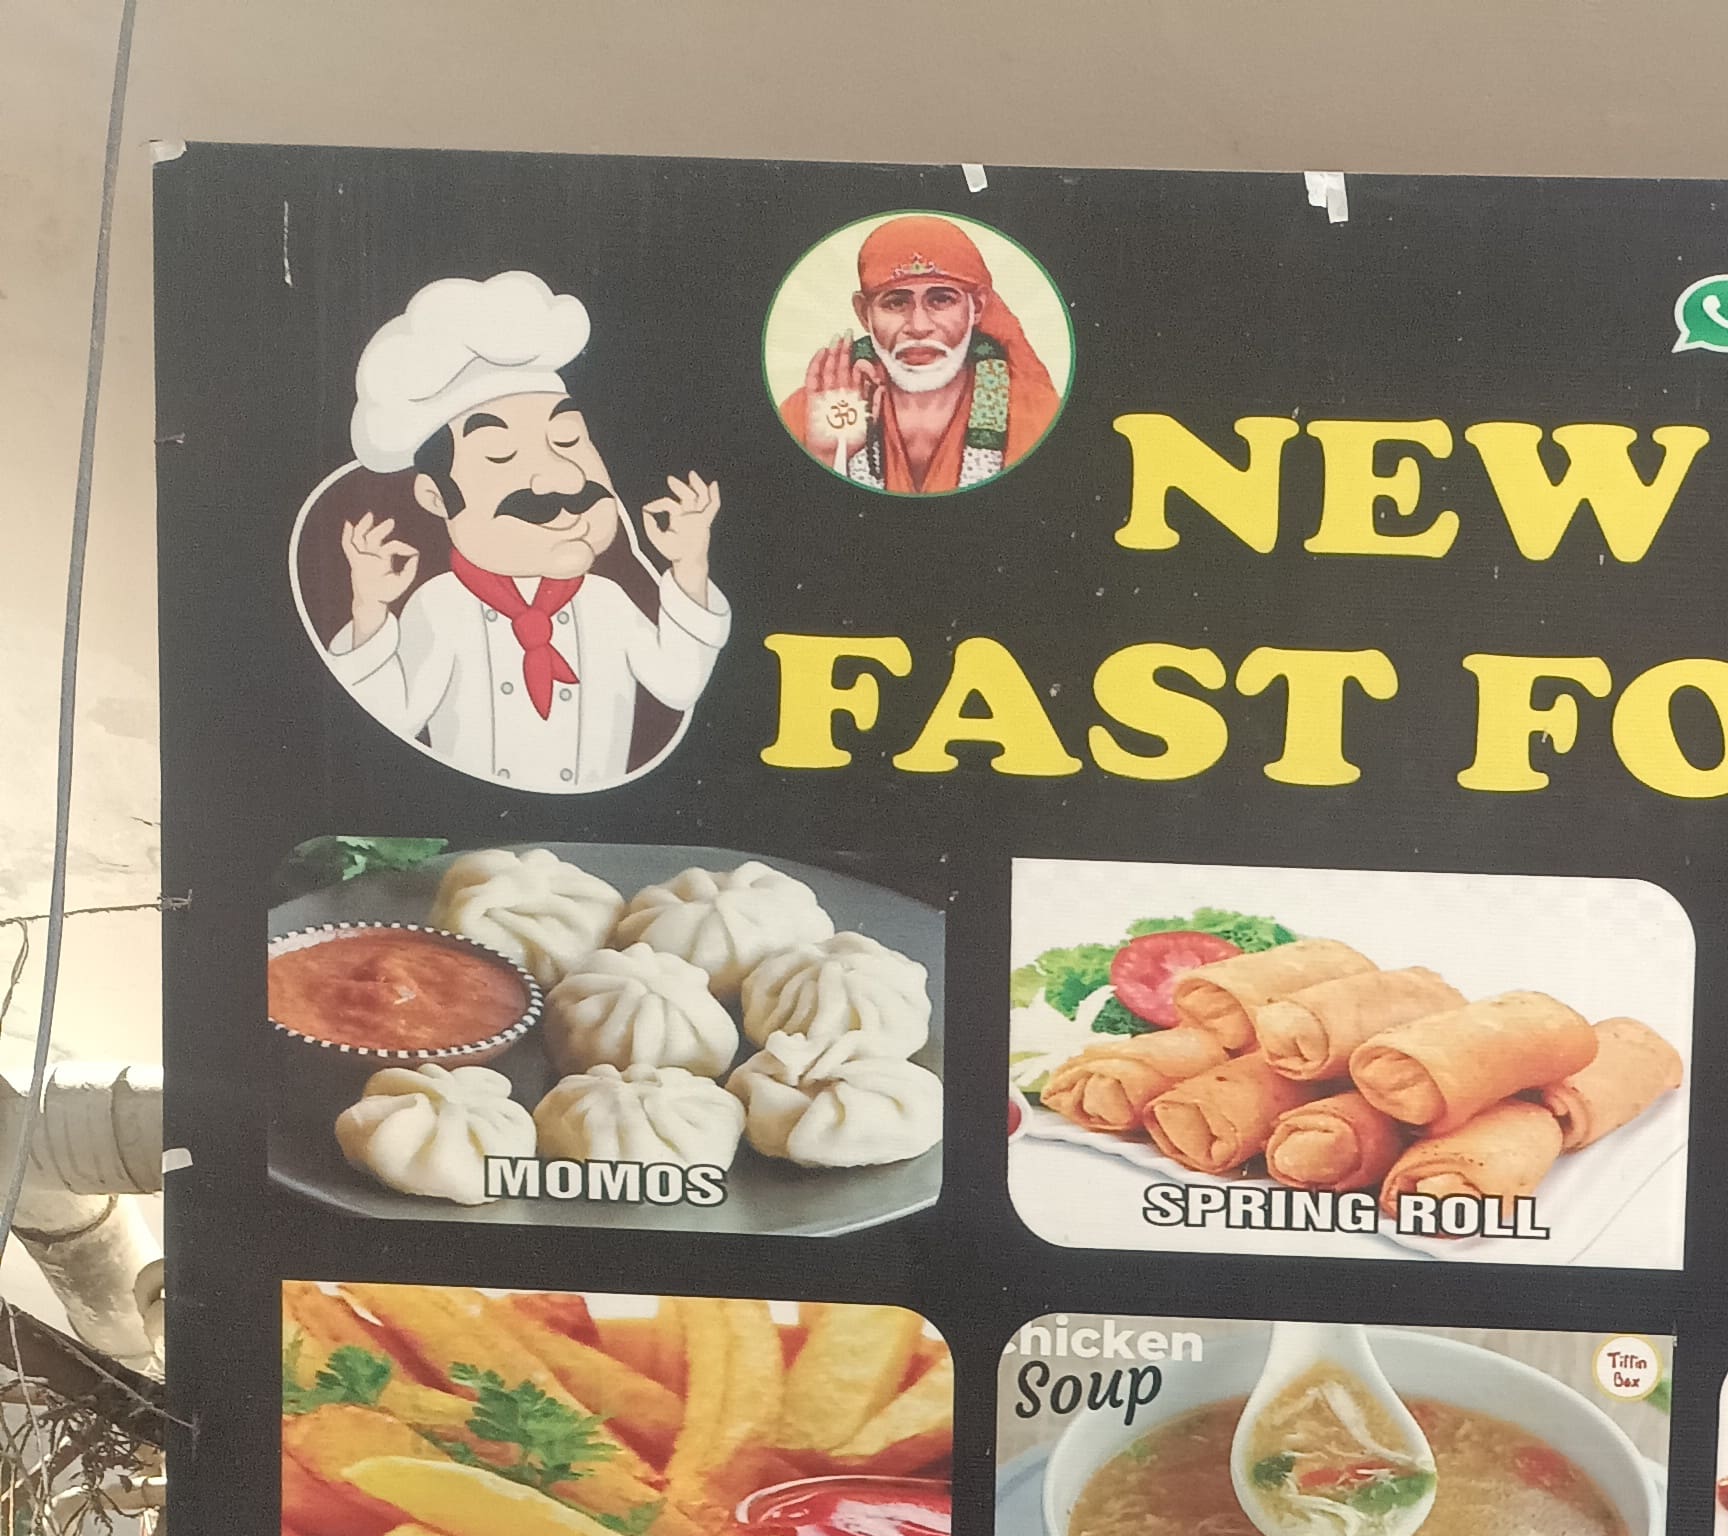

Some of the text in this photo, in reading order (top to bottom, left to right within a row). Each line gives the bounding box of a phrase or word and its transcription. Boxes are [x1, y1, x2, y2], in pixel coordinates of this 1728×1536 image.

[1113, 413, 1711, 564] NEW
[759, 633, 1400, 787] FAST
[485, 1156, 725, 1208] MOMOS
[1142, 1183, 1550, 1241] SPRING ROLL
[1015, 1360, 1162, 1426] Soup
